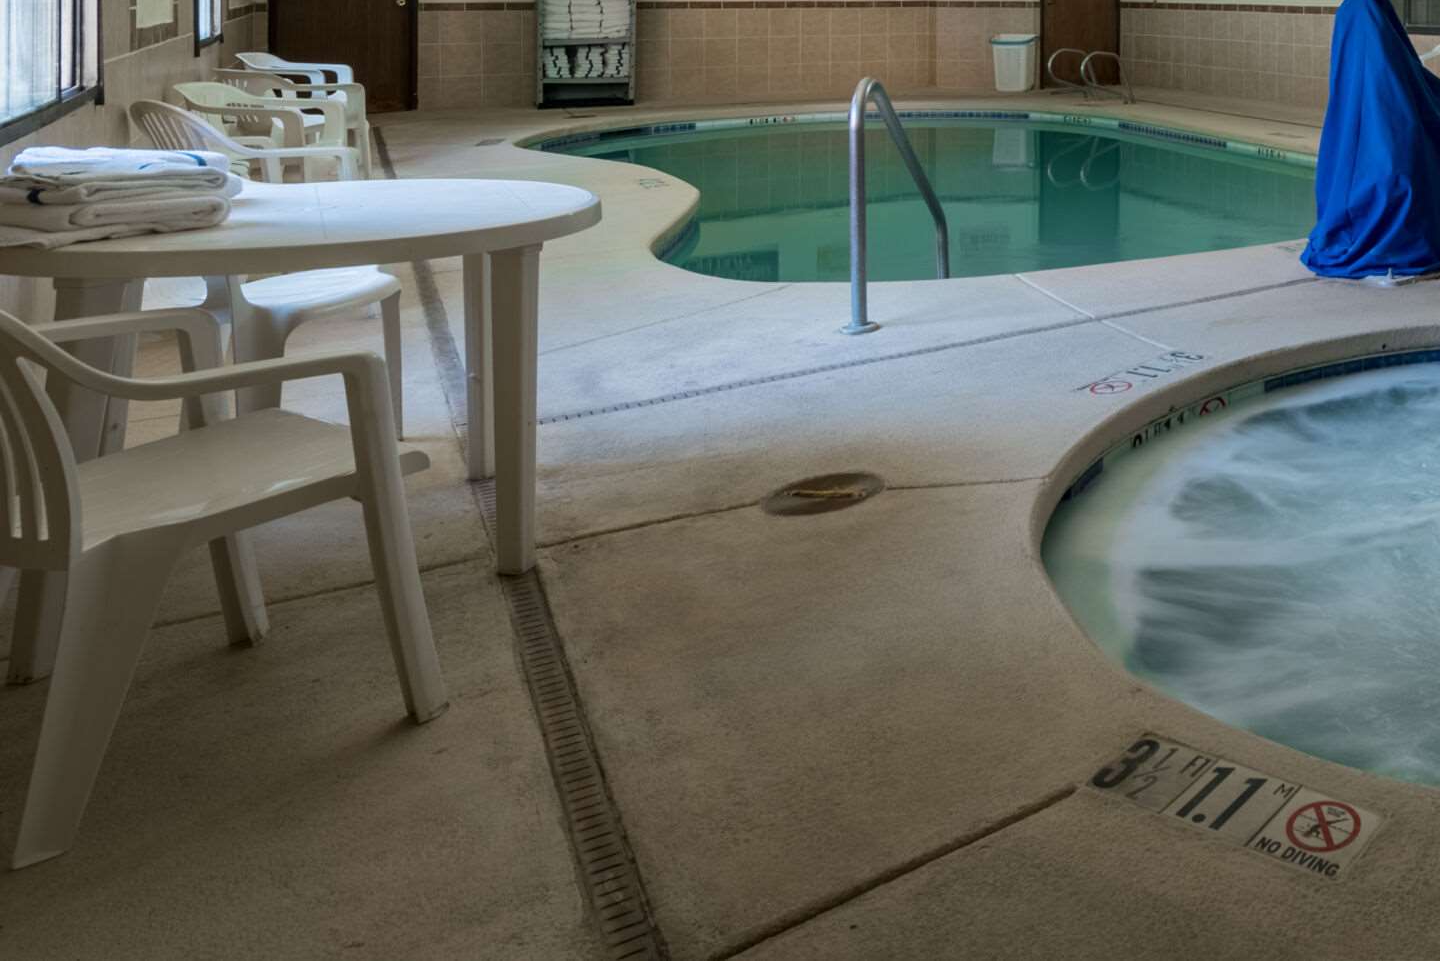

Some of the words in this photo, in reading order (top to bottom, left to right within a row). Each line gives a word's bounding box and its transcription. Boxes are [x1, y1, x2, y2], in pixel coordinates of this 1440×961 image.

[1176, 766, 1268, 831] 1.1
[1273, 782, 1295, 799] M
[1255, 836, 1281, 853] NO
[1281, 849, 1340, 877] DIVING
